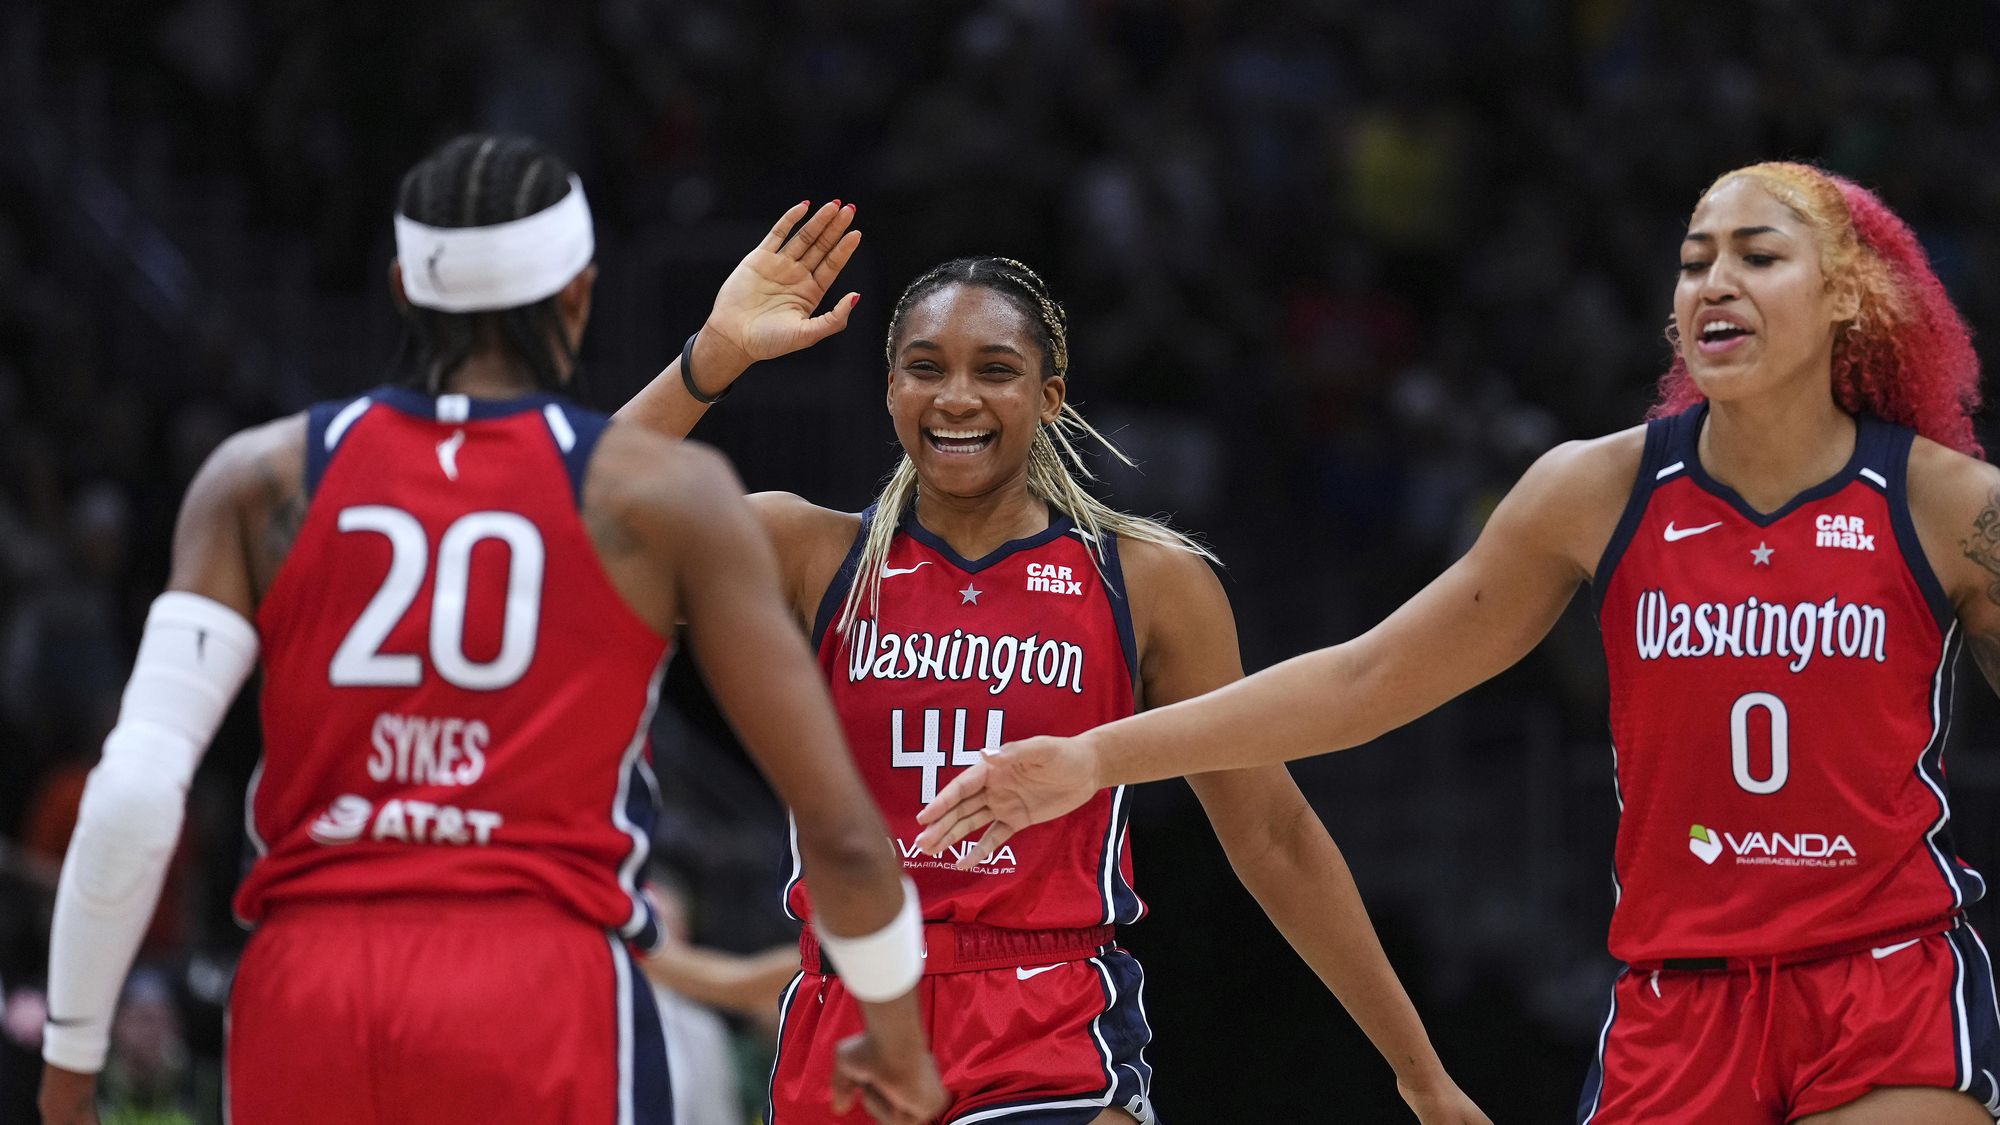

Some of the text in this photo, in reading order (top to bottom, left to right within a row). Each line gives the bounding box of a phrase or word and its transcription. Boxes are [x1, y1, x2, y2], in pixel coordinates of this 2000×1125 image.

[1816, 514, 1865, 533] CAR
[1815, 531, 1875, 551] max
[1026, 562, 1073, 580] CAR
[328, 504, 546, 691] 20
[1026, 577, 1082, 595] max
[1636, 588, 1887, 673] Washington
[849, 616, 1084, 695] Washington
[367, 713, 490, 787] SYKES
[1730, 690, 1790, 795] 0
[371, 799, 502, 845] AT&T
[1724, 831, 1857, 858] VANDA
[903, 861, 999, 875] PHARMACEICALS
[1736, 856, 1837, 868] PHARMACEUTICALS
